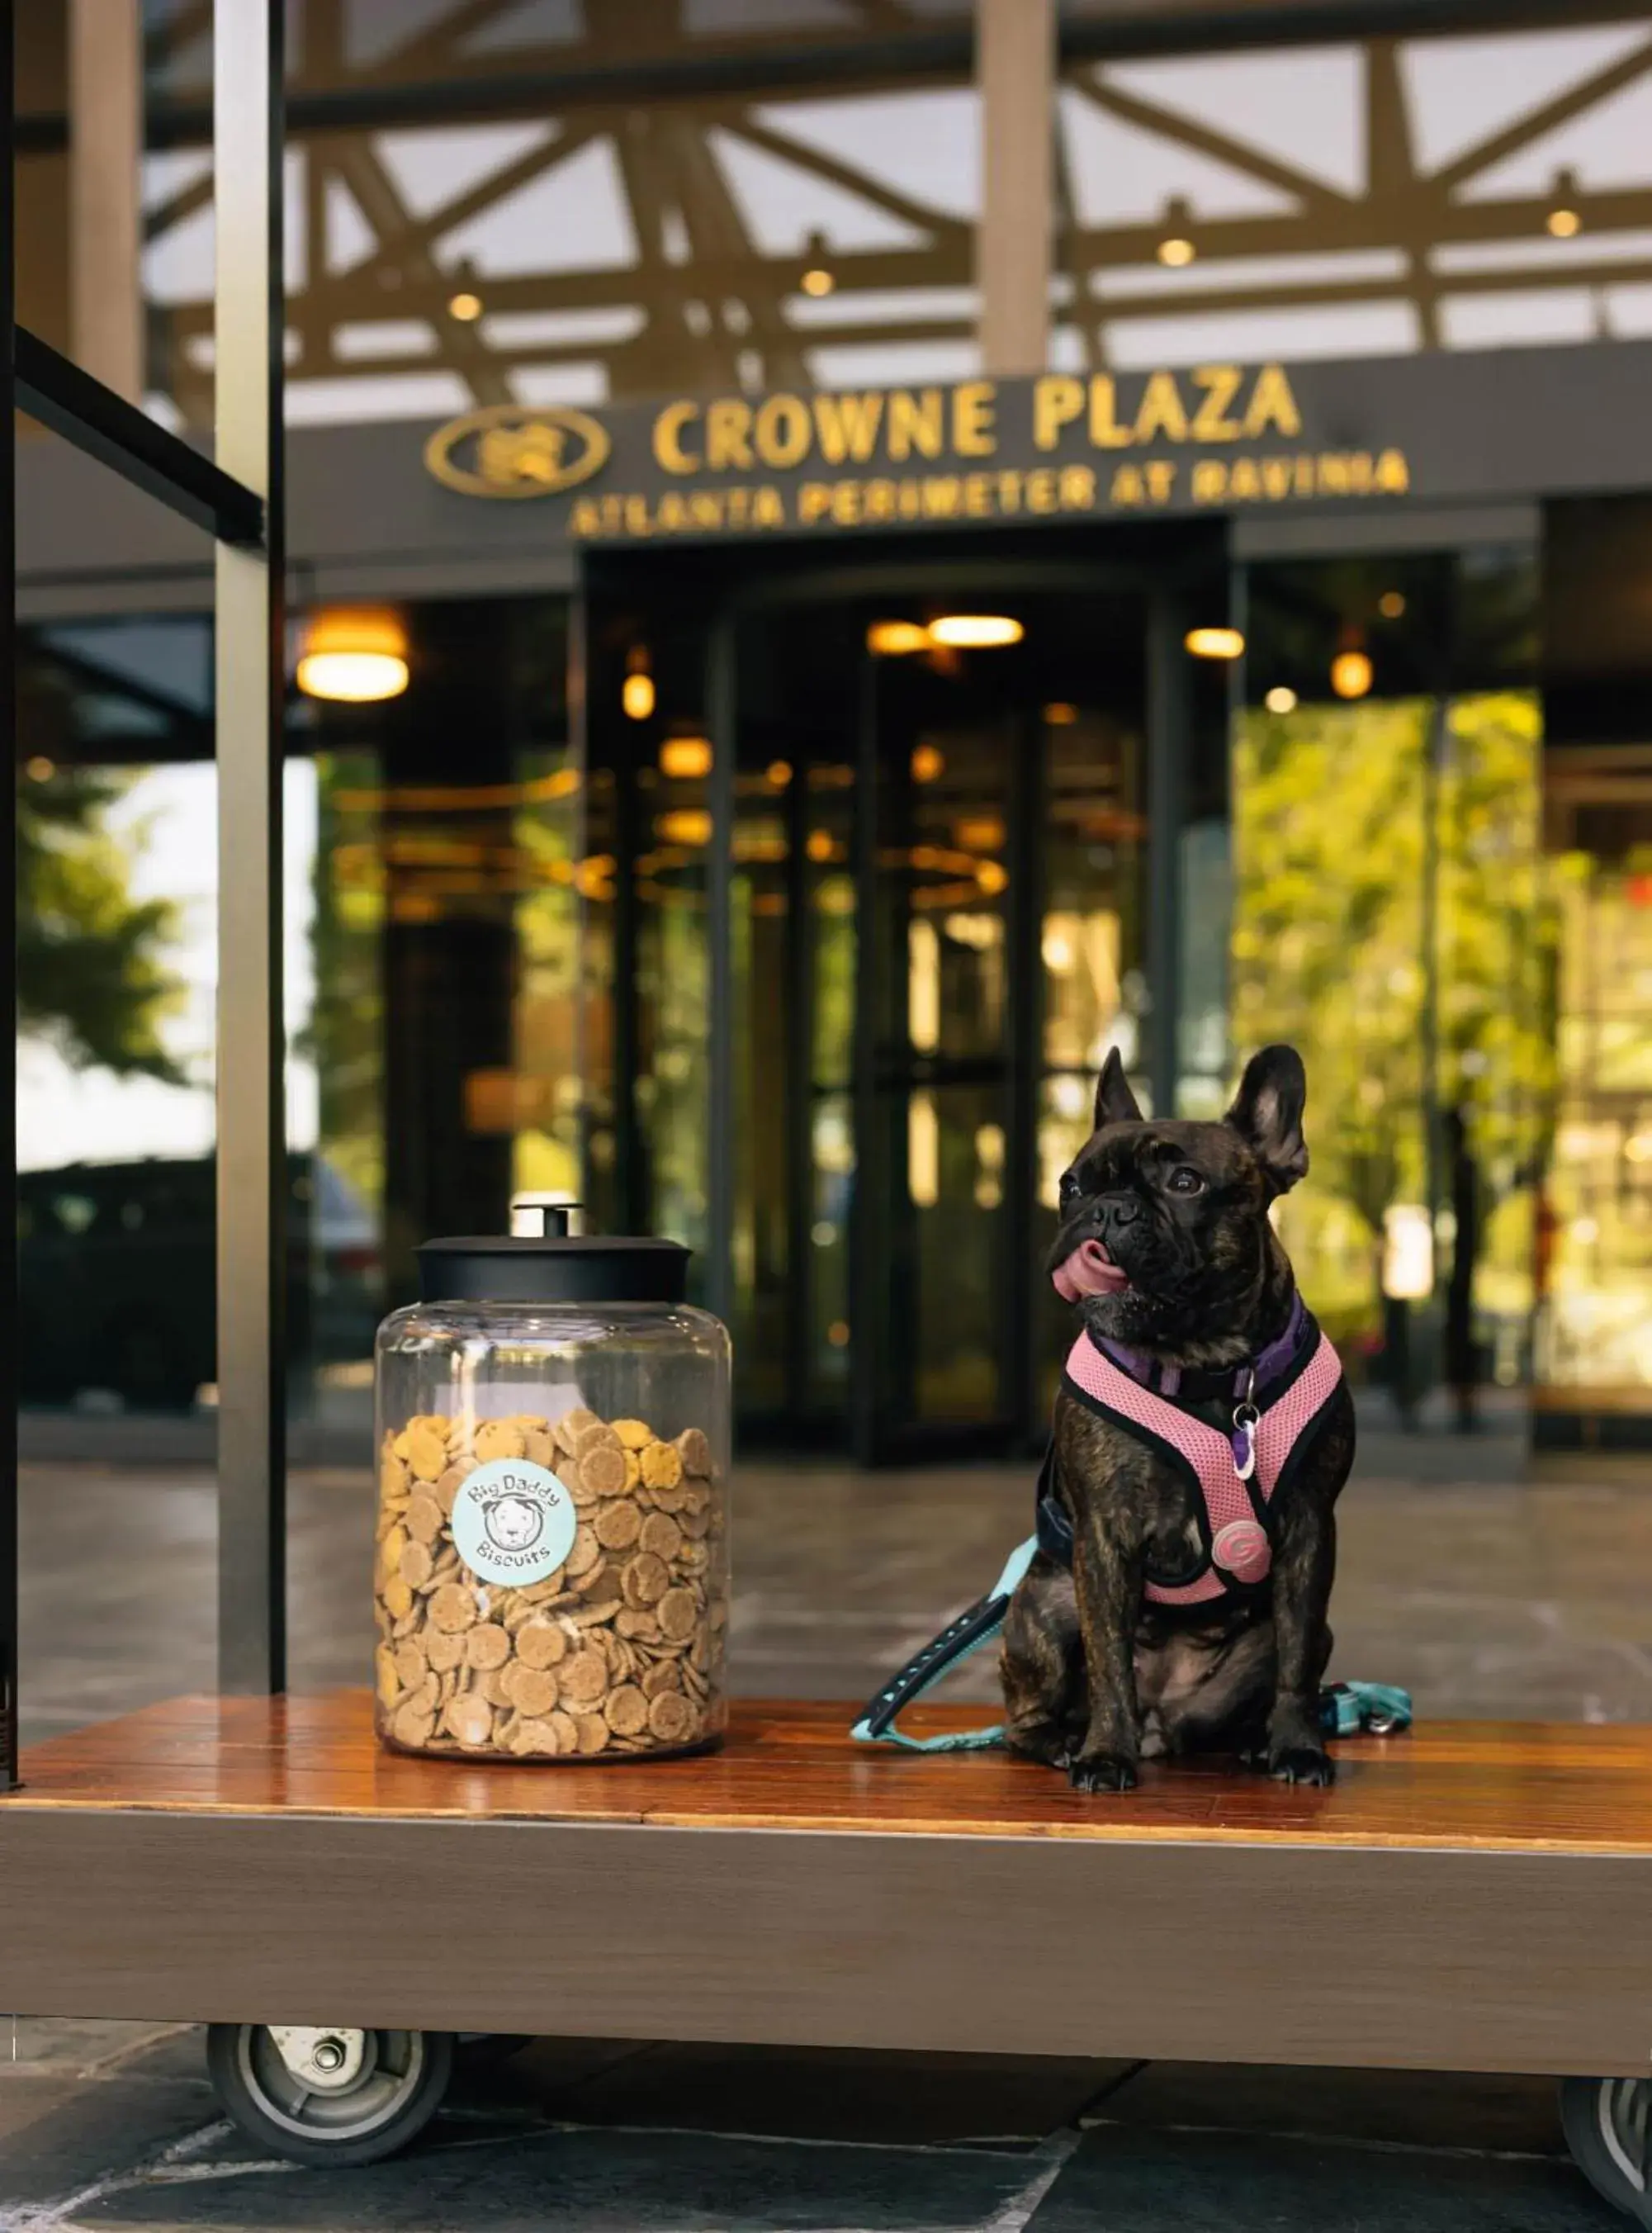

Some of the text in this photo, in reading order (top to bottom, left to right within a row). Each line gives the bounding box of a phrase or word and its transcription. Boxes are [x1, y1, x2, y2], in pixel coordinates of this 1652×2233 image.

[652, 362, 1301, 474] CROWNE PLAZA
[570, 448, 1408, 538] ATLANTA PERIMETER AT RAVINIA
[467, 1474, 561, 1507] Big Daddy
[476, 1539, 551, 1567] Biscuits
